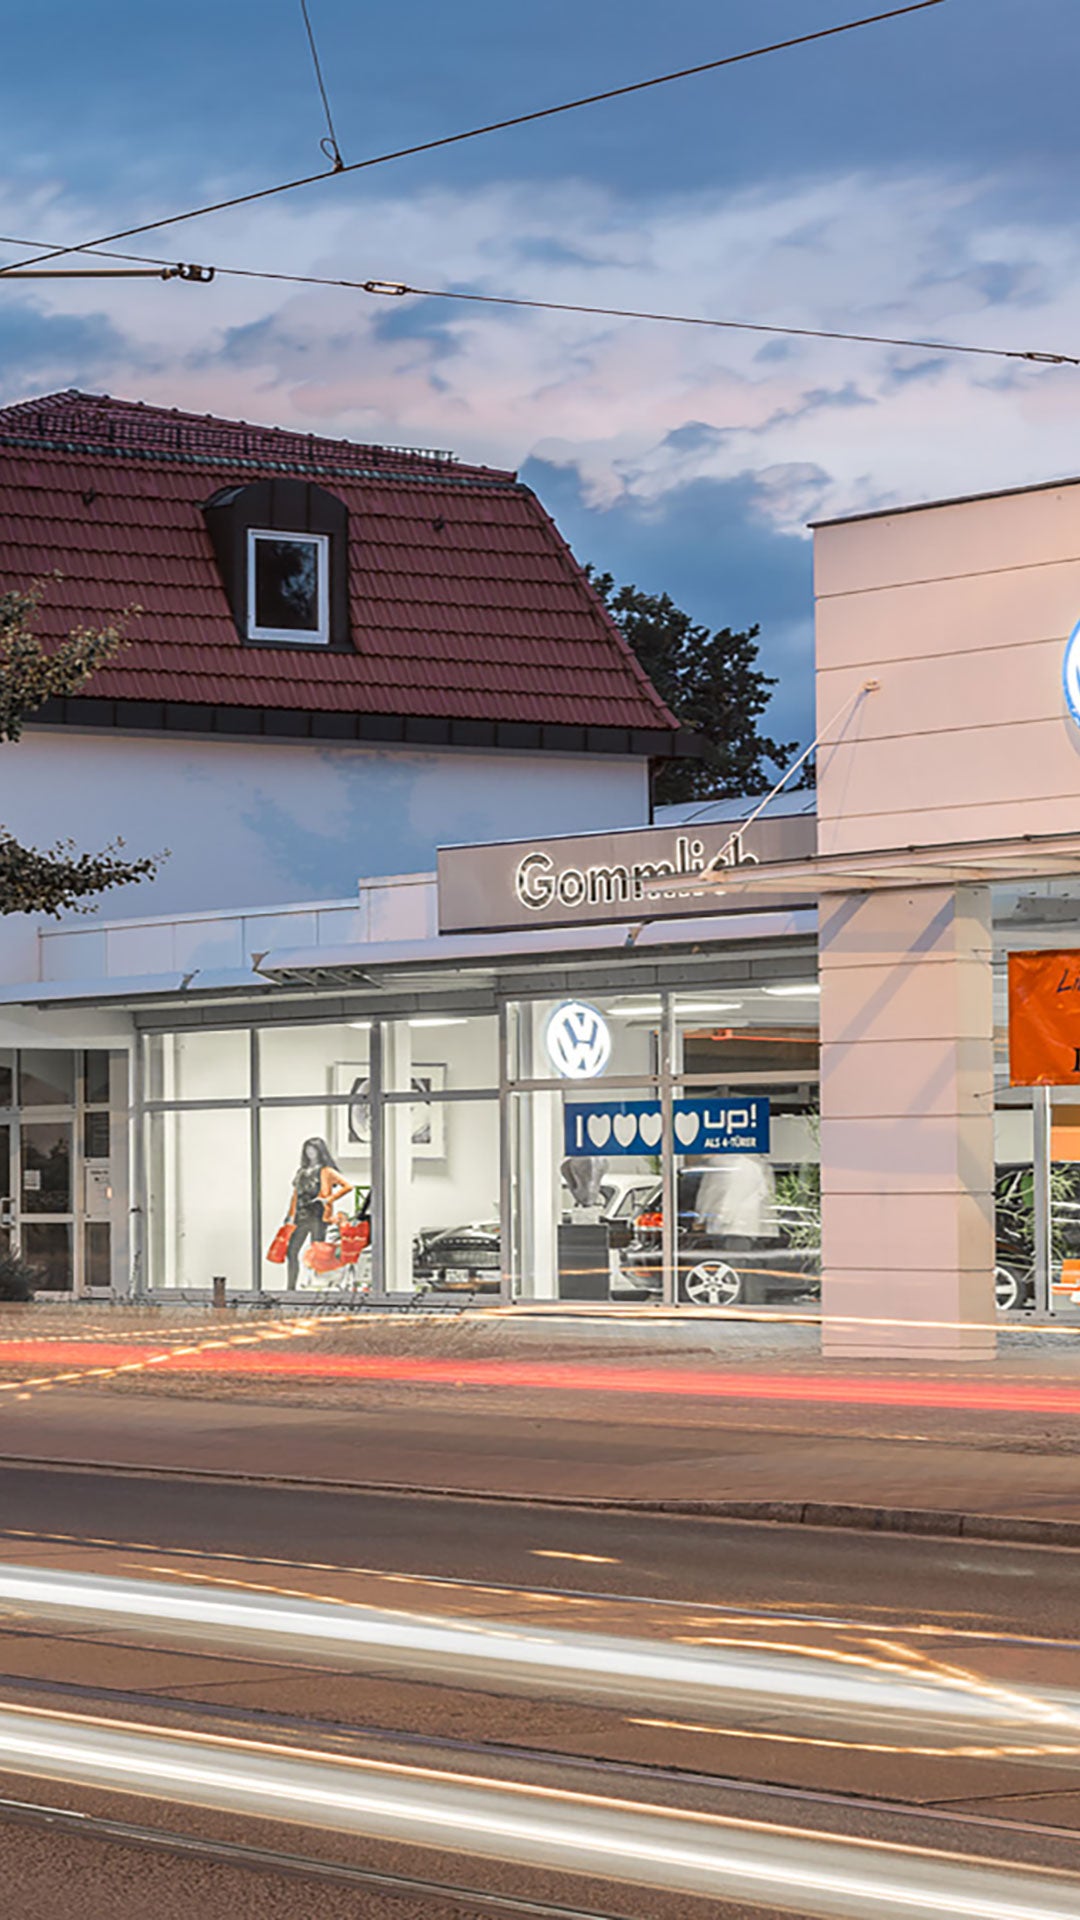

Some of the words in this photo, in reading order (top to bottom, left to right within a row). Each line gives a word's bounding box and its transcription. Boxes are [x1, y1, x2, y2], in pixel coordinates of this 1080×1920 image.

[549, 1001, 610, 1078] VW
[576, 1114, 583, 1148] I
[703, 1103, 757, 1135] up!
